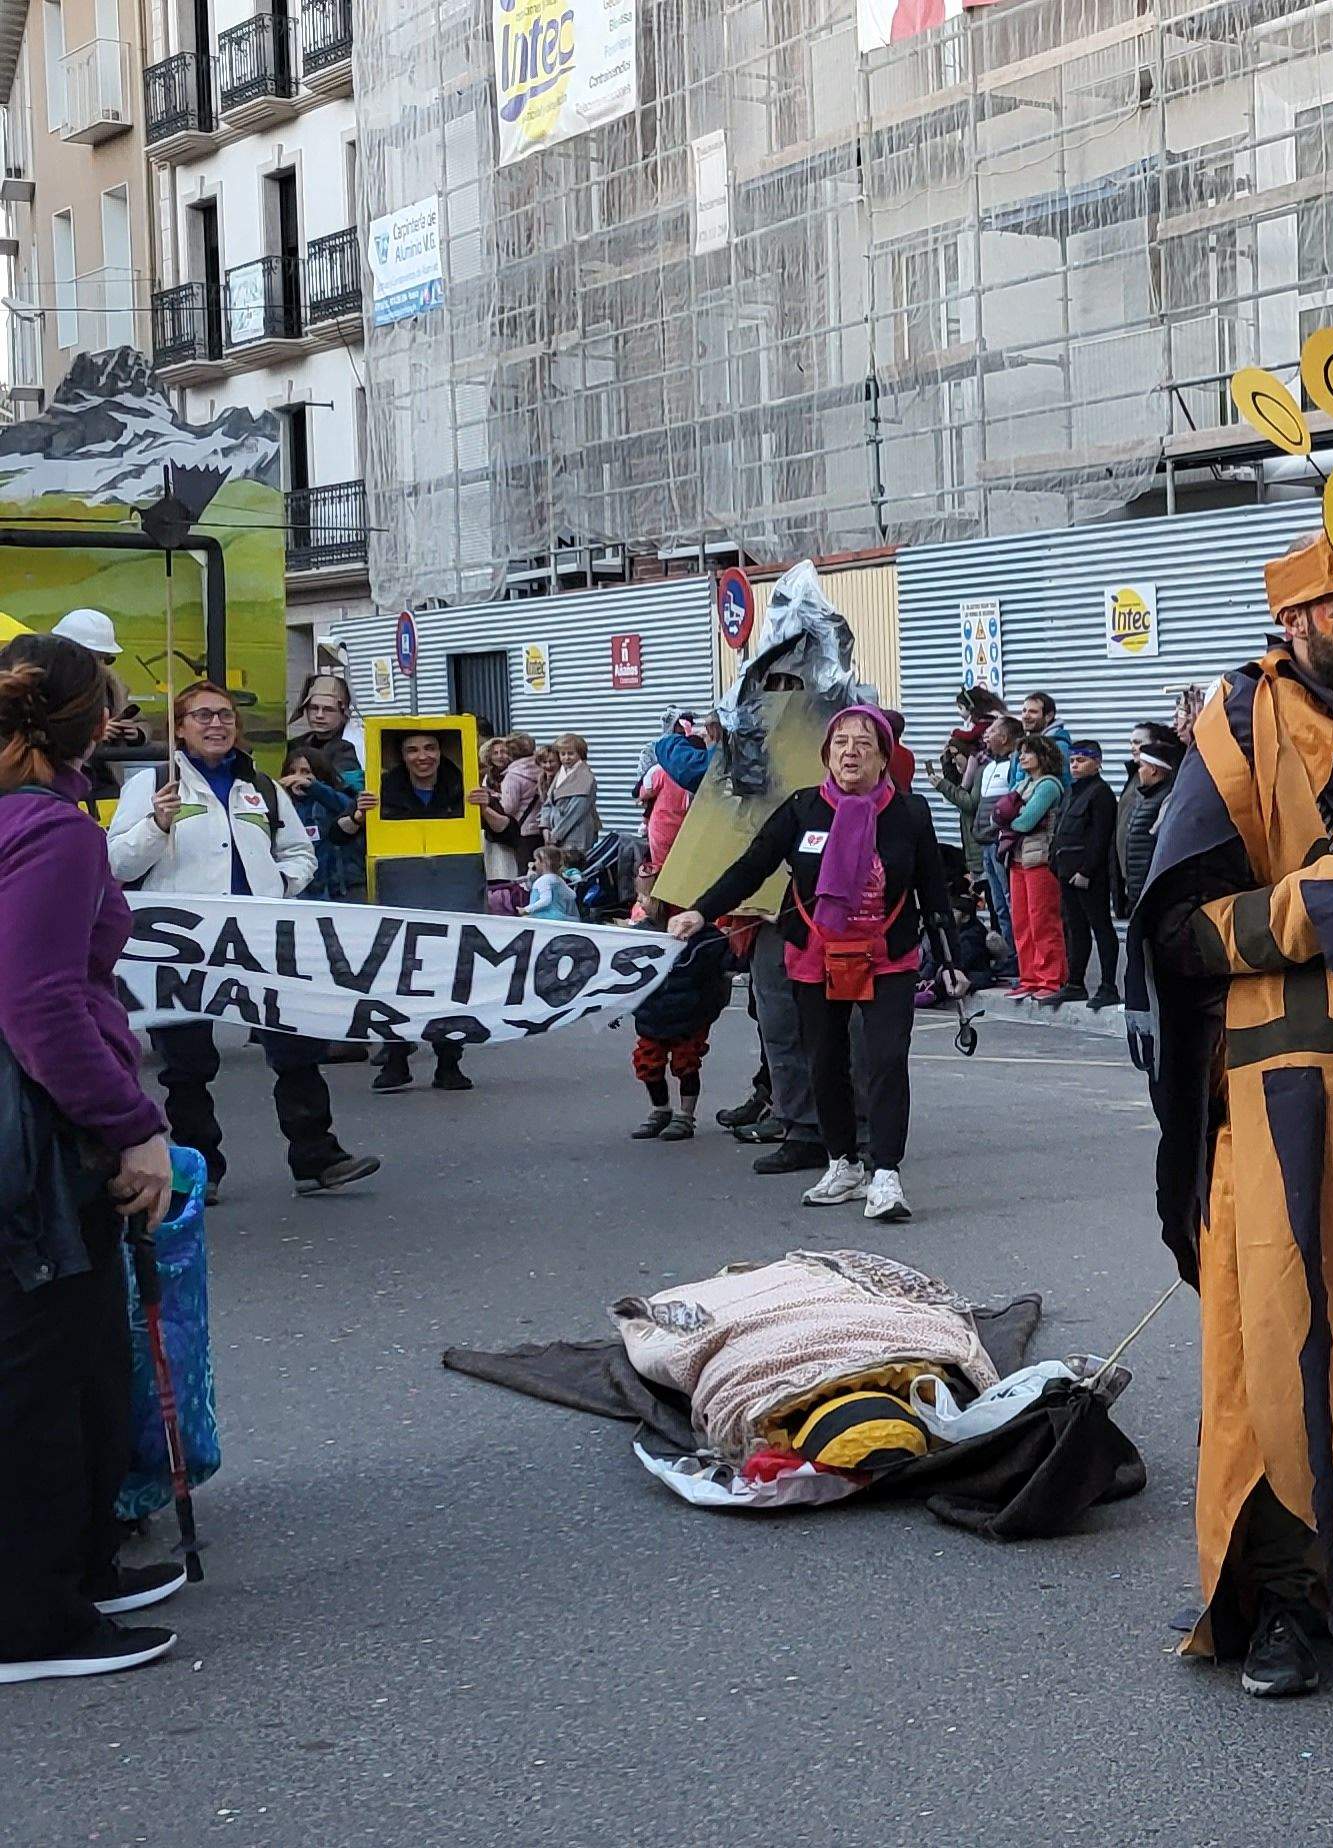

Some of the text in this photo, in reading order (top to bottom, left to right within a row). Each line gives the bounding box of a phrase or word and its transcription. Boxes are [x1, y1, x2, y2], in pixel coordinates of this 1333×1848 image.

[501, 9, 575, 92] Intec
[1112, 606, 1151, 631] Intec
[118, 907, 665, 1008] SALVEMOS
[346, 999, 602, 1044] ROY
